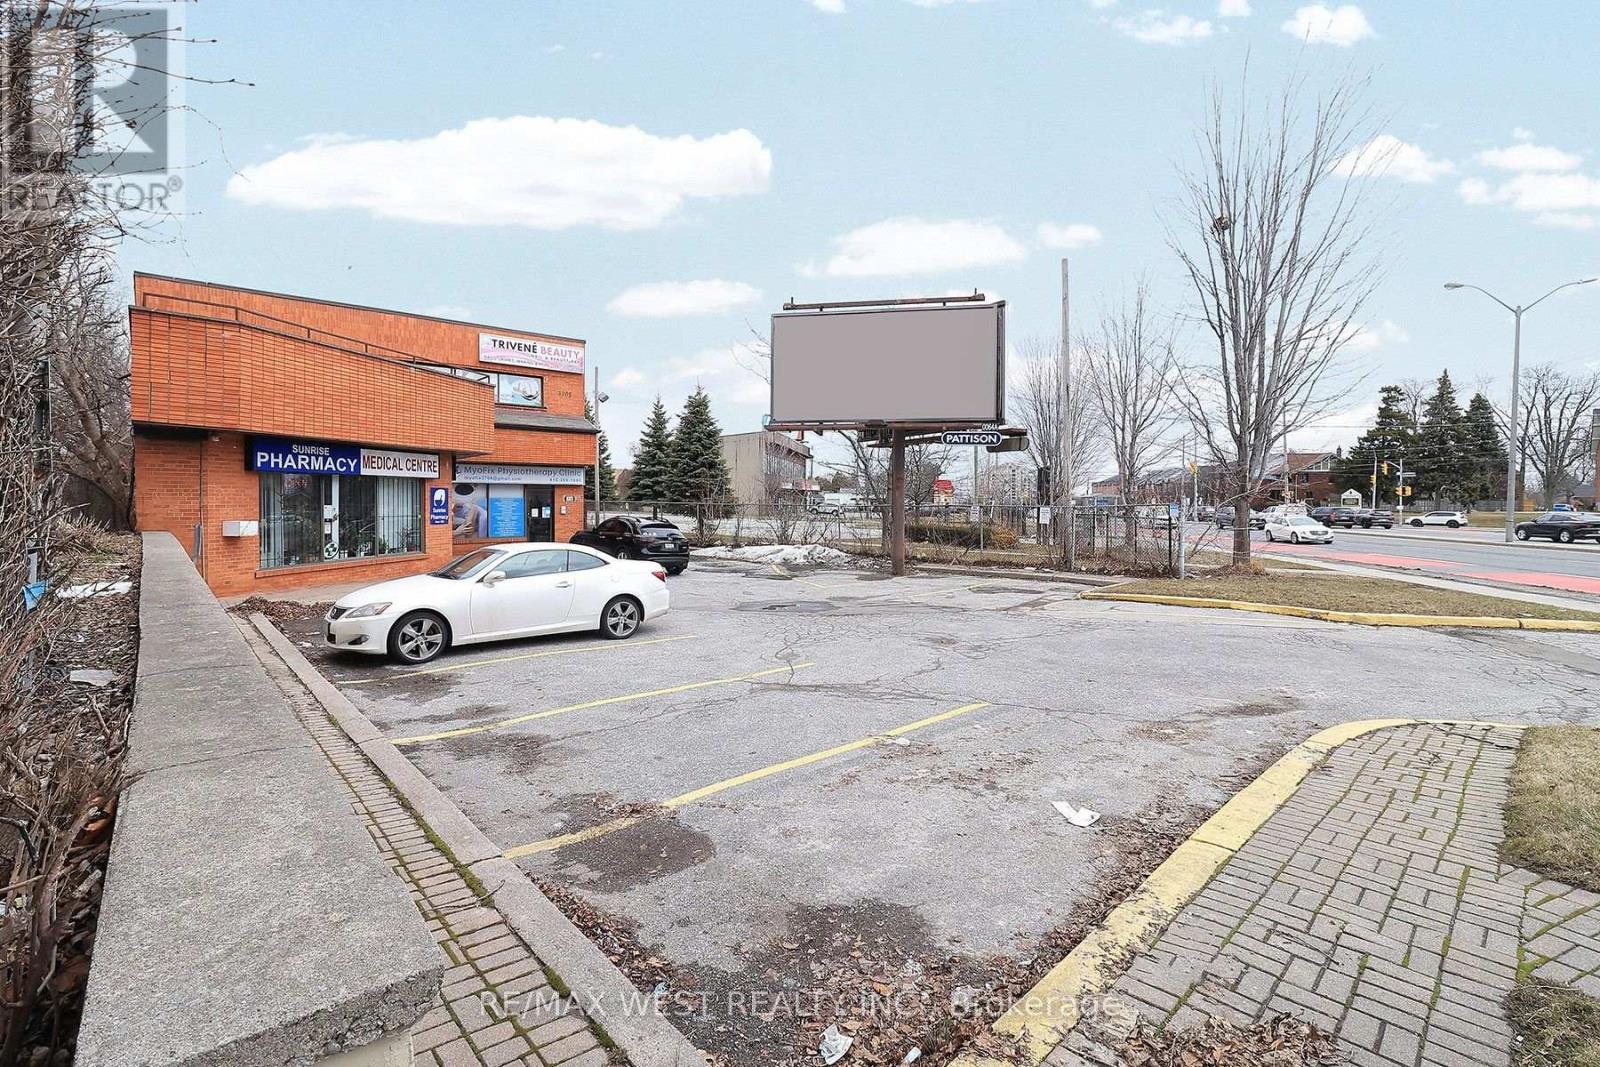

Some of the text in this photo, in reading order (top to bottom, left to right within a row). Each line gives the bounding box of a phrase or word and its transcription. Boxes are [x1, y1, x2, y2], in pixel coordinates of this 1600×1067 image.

[492, 339, 580, 359] TRIVENÉ BEAUTY
[946, 434, 998, 444] PATTISON
[292, 444, 330, 456] SUNRISE
[256, 451, 358, 472] PHARMACY
[362, 454, 438, 473] MEDICAL CENTRE
[464, 466, 495, 475] MyoFix
[497, 467, 558, 478] Physiotherapy
